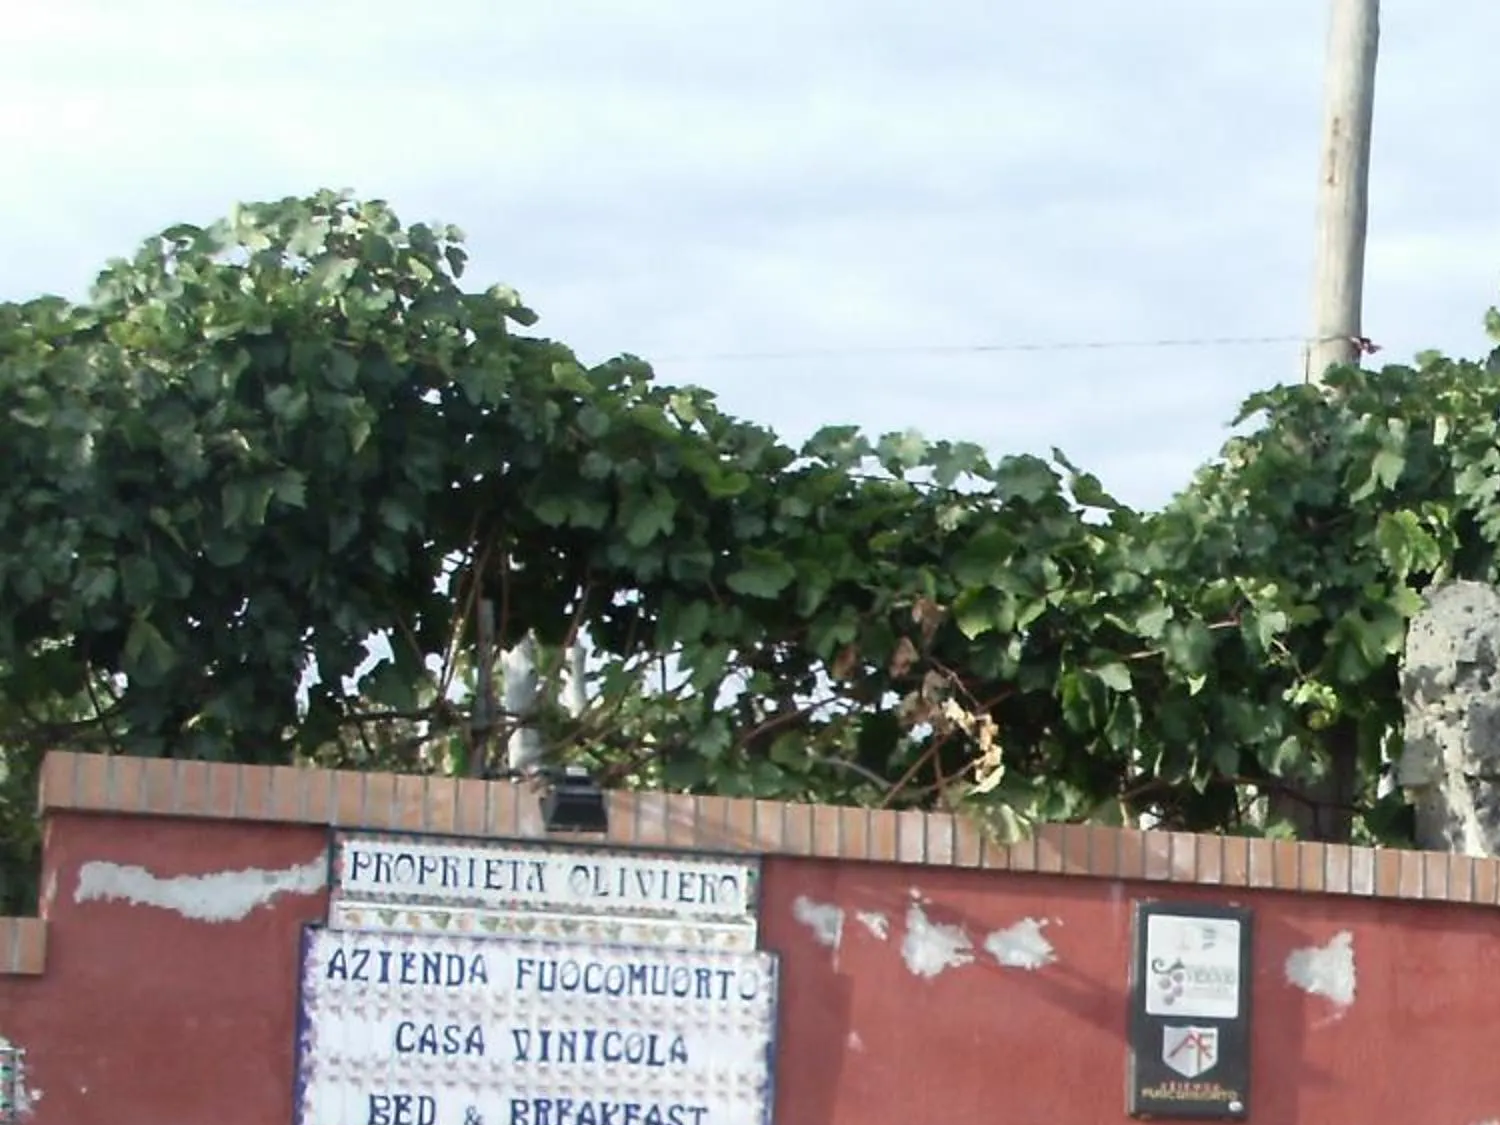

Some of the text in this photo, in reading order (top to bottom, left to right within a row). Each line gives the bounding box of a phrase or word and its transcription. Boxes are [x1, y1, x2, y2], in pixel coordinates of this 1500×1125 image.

[569, 864, 739, 905] OLIVIERO
[326, 948, 758, 1001] AZIENDA FUOCOMUORTO
[395, 1020, 689, 1067] CASA VINICOLA
